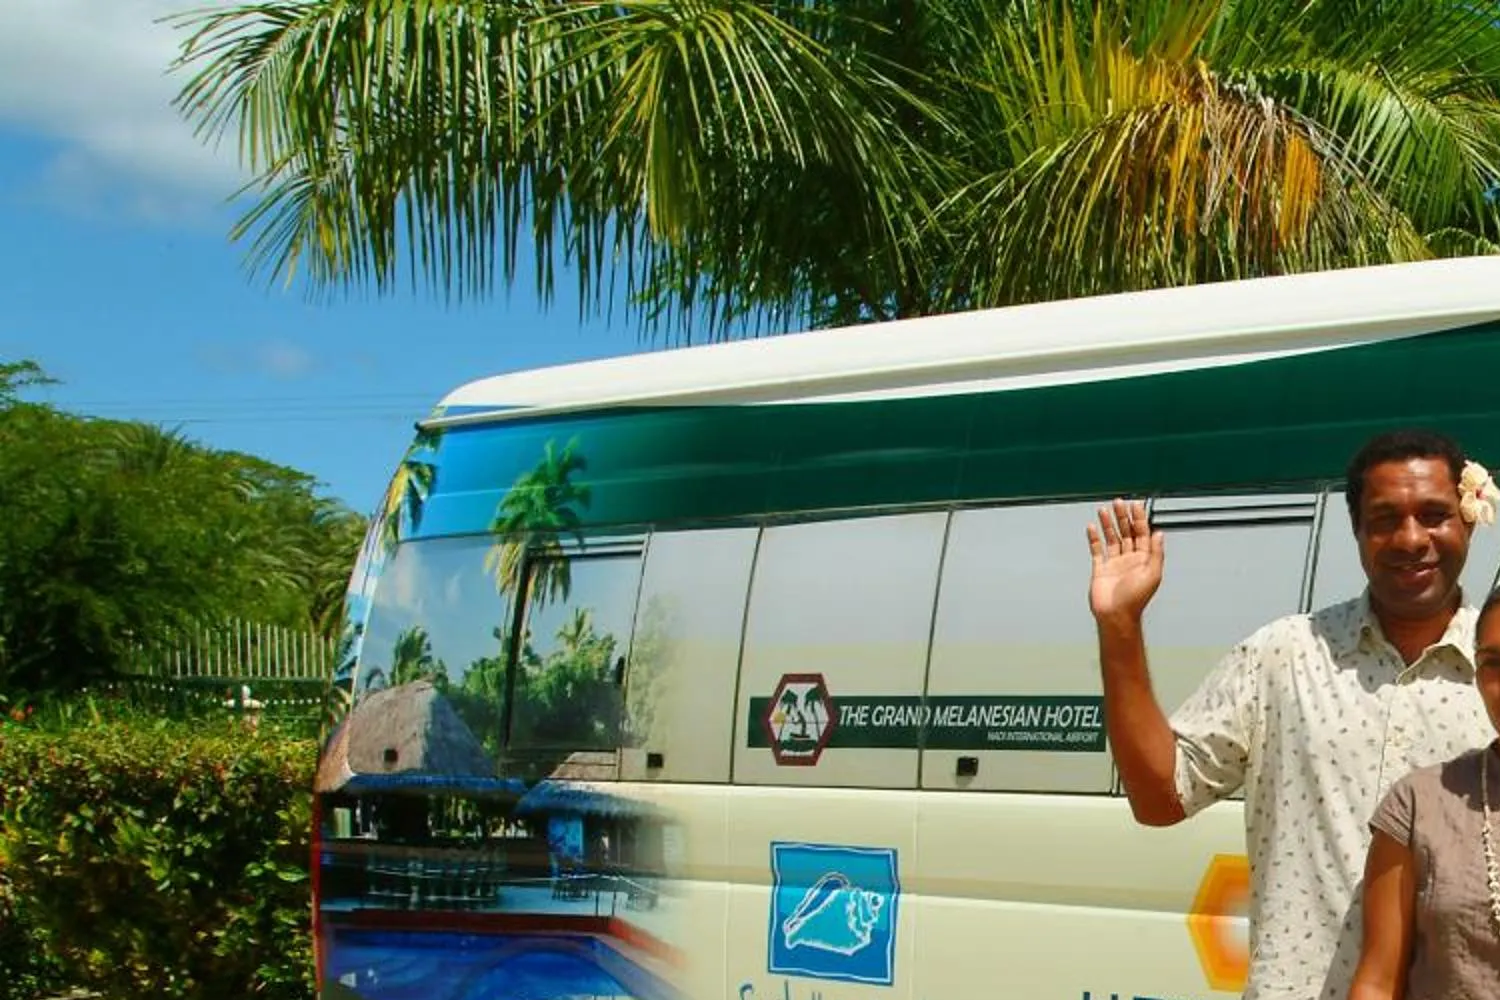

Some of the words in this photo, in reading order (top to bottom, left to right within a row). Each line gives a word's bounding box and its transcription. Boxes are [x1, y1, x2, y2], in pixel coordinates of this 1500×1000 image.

[840, 704, 871, 728] THE
[871, 704, 932, 728] GRAND
[933, 704, 1042, 728] MELANESIAN
[1043, 704, 1103, 729] HOTEL
